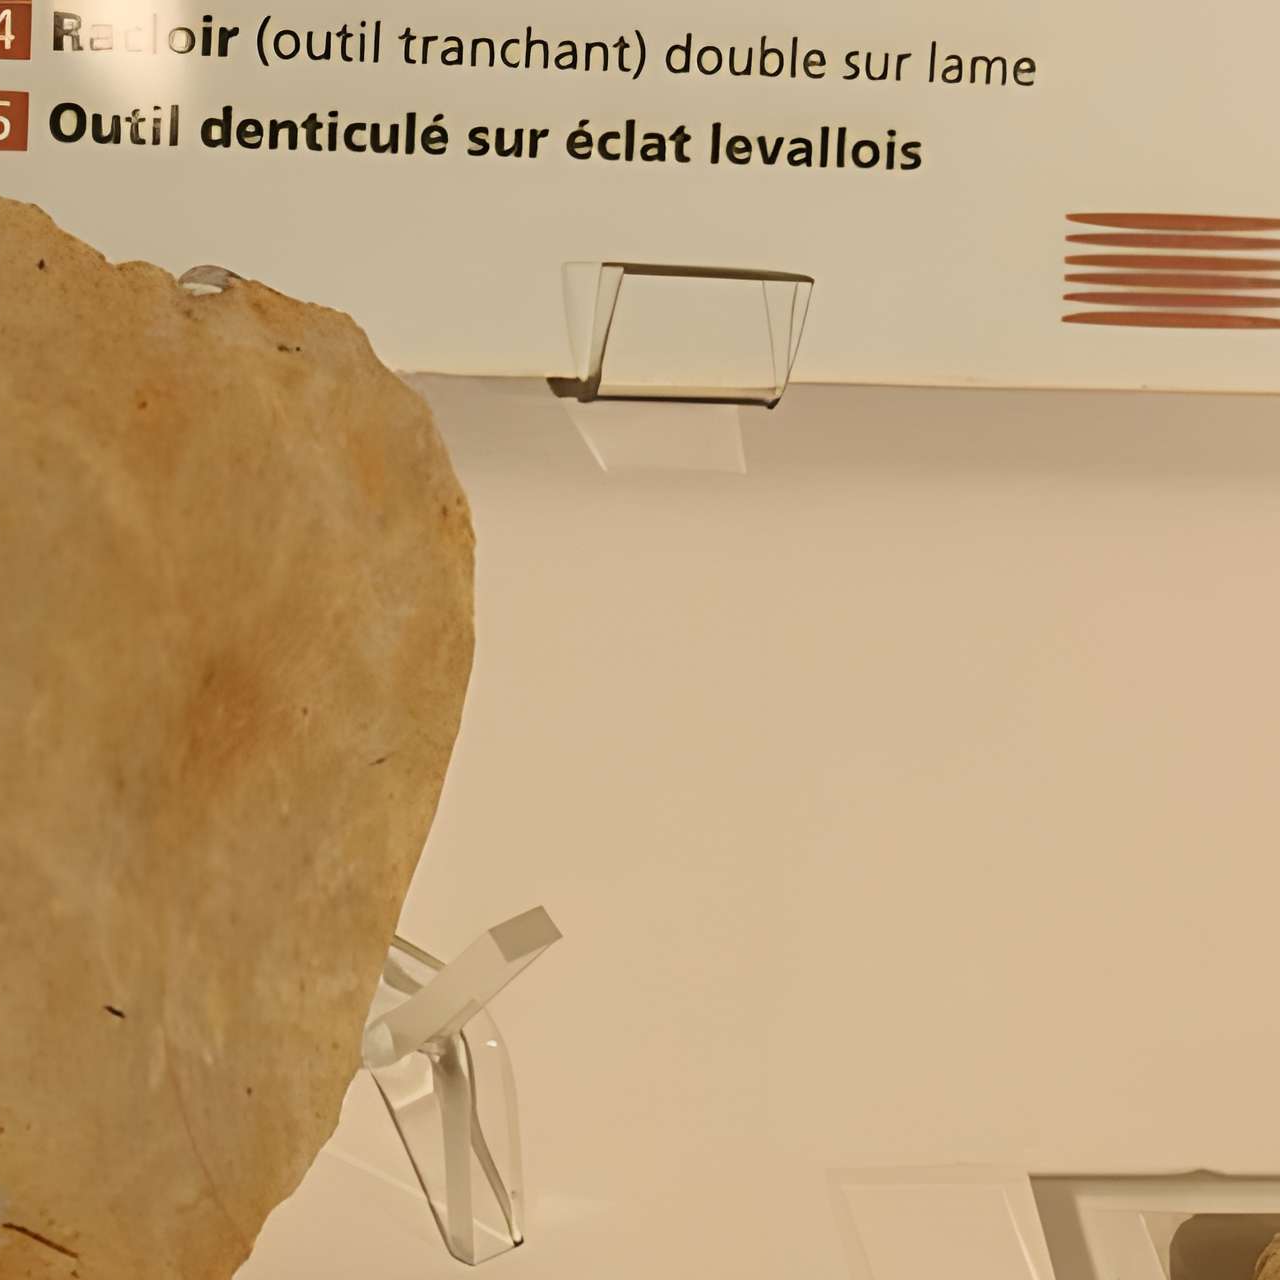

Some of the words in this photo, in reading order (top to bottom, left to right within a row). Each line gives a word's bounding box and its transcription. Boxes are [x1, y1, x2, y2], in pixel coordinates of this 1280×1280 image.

[257, 15, 381, 67] (outil
[398, 26, 646, 80] tranchant)
[665, 33, 826, 80] double
[842, 49, 912, 82] sur
[929, 41, 1036, 87] lame
[49, 102, 179, 146] Outil
[201, 105, 448, 156] denticulé
[467, 126, 549, 159] sur
[566, 119, 692, 164] éclat
[710, 122, 923, 171] levallois
